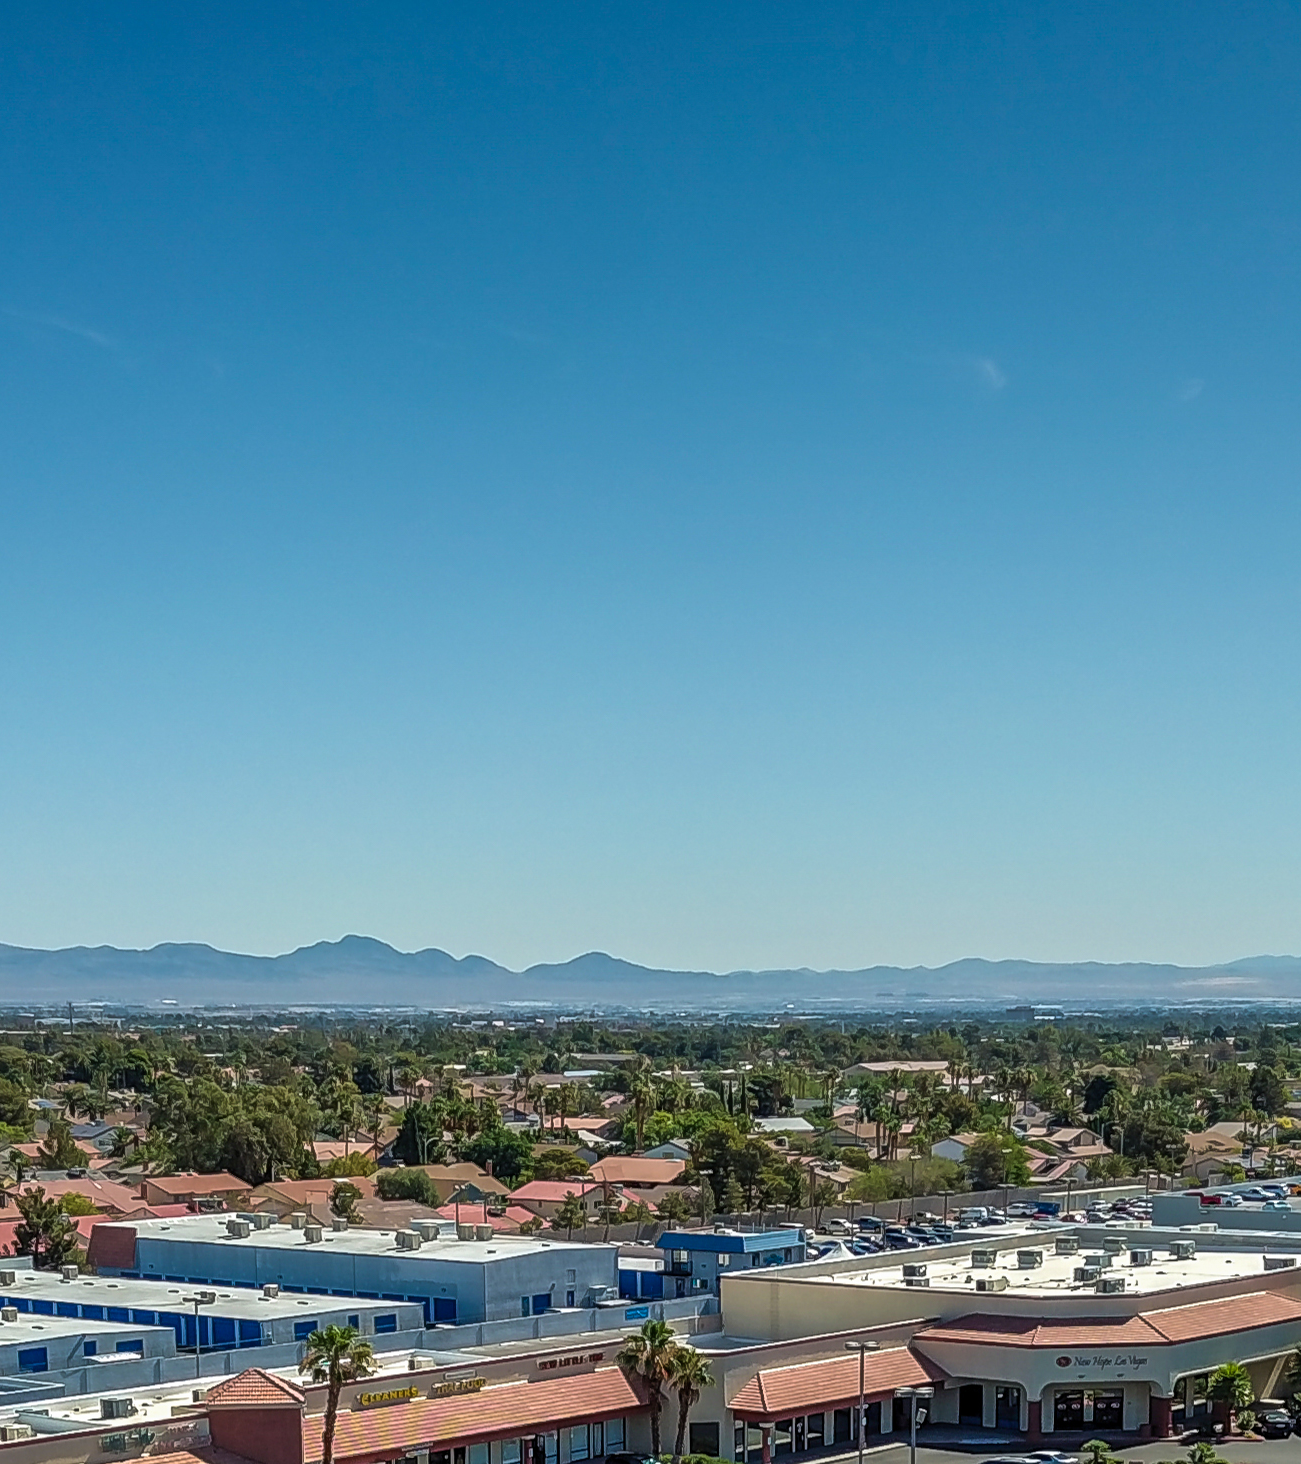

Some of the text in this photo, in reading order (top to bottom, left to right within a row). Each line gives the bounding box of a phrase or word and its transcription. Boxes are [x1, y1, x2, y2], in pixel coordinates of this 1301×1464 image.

[1074, 1355, 1148, 1371] New Hope Las Vegas
[361, 1385, 418, 1406] CLEANERS
